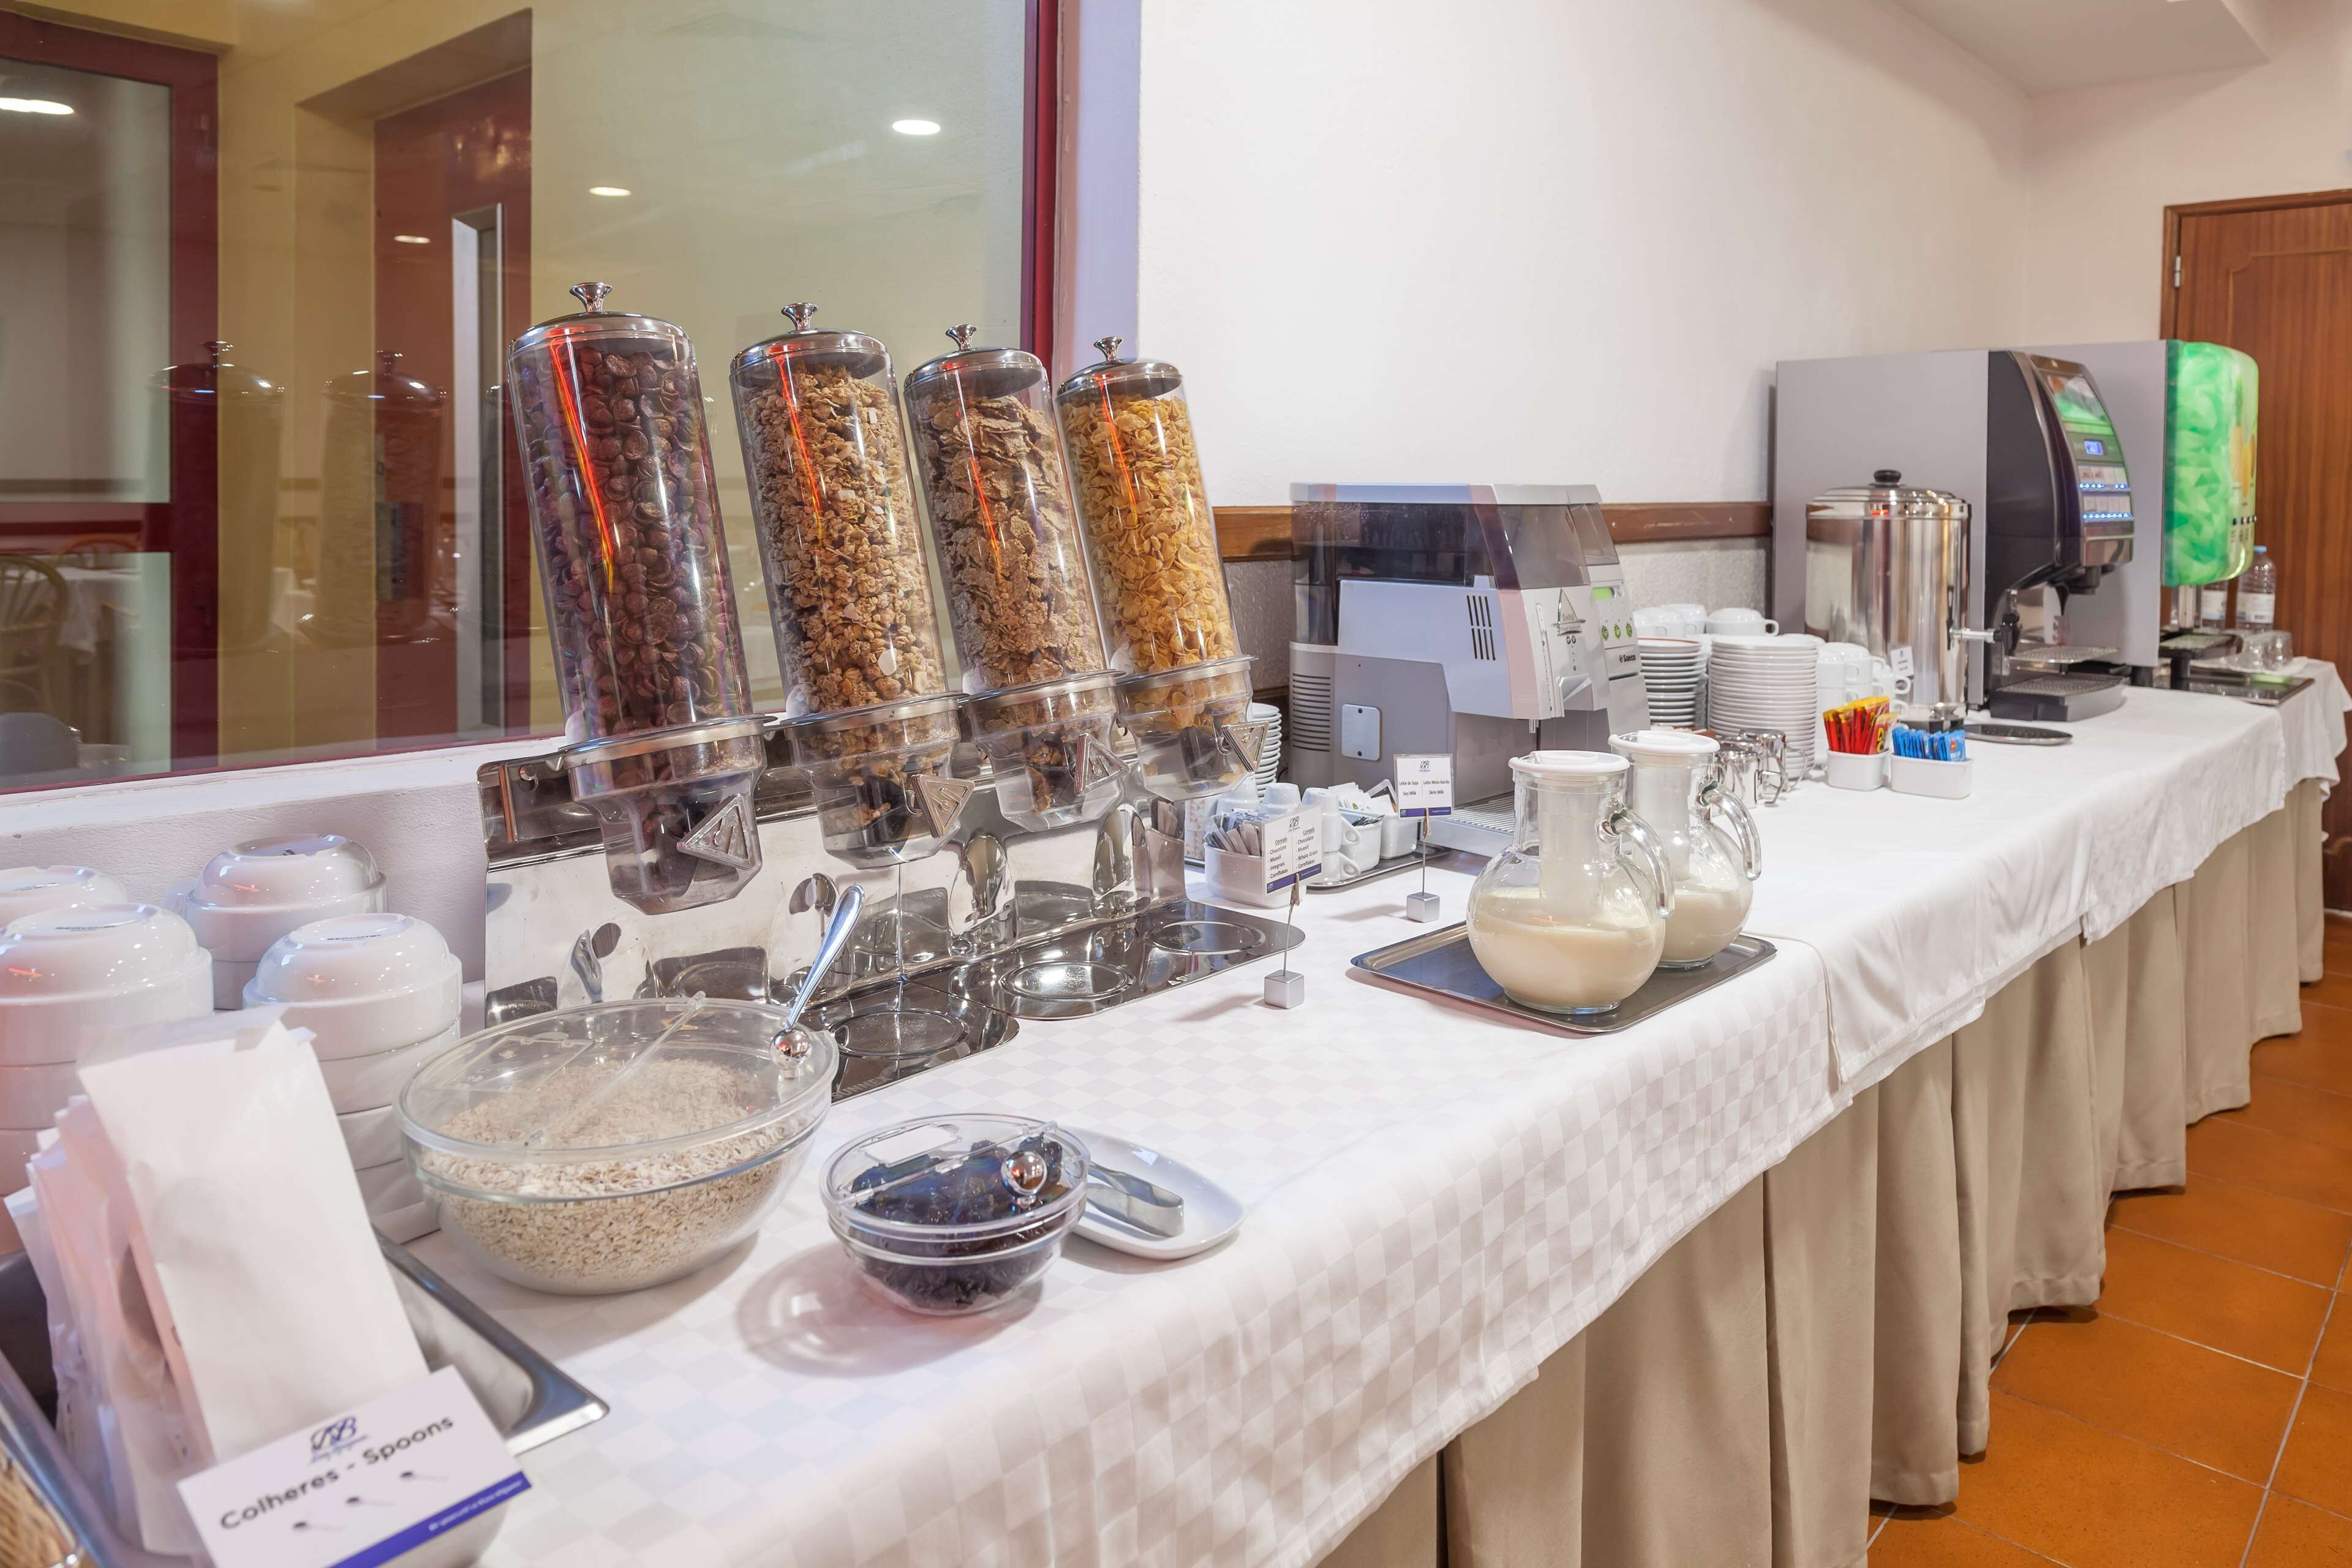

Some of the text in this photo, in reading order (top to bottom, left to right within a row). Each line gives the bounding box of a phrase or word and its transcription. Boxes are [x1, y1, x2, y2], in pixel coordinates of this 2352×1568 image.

[1298, 835, 1314, 845] Chocolate
[1270, 845, 1287, 854] Chocolate
[1298, 859, 1315, 869] Cornflakes
[1270, 869, 1288, 878] Cornflakes
[220, 1469, 339, 1529] Colheres
[363, 1416, 454, 1466] Spoons
